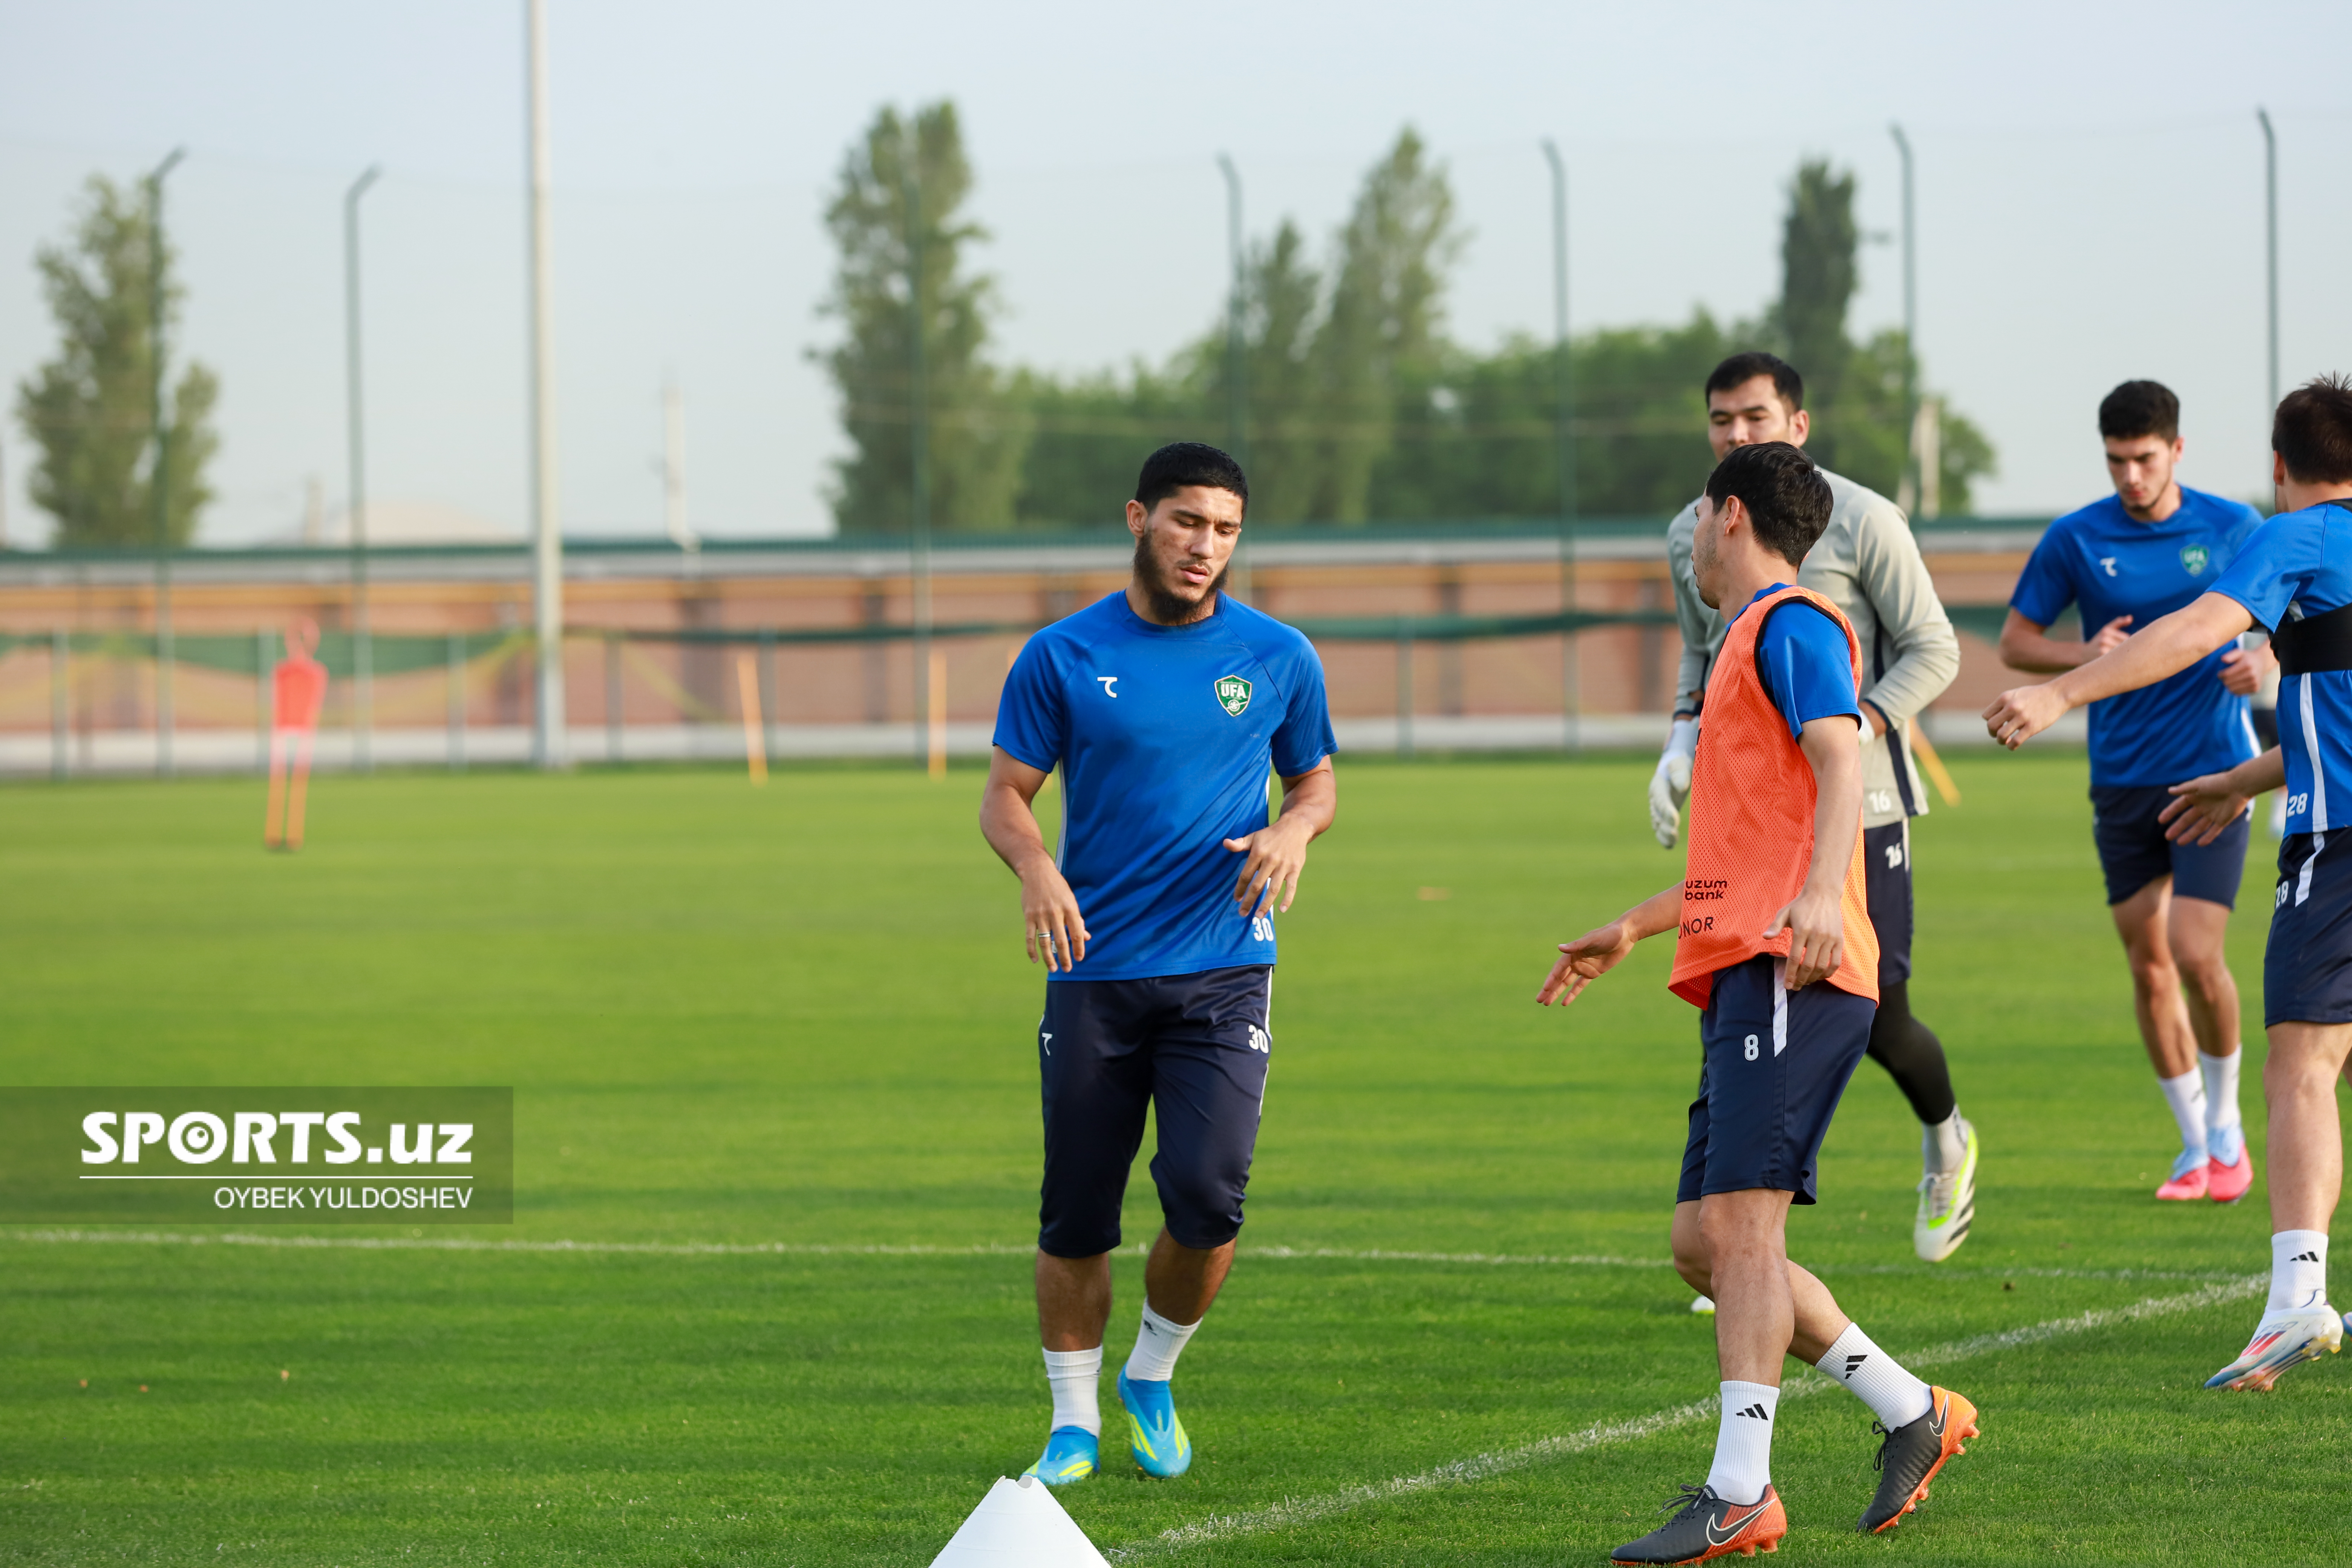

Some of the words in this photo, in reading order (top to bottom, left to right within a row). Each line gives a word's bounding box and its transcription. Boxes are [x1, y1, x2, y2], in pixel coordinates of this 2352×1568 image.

[1220, 684, 1246, 698] UFA
[1868, 789, 1891, 814] 16
[2287, 792, 2308, 818] 28
[1885, 842, 1903, 870] 16
[1684, 890, 1724, 900] bank
[1686, 880, 1727, 889] uzum
[1252, 916, 1274, 942] 30
[1248, 1024, 1269, 1054] 30
[1744, 1034, 1759, 1061] 8
